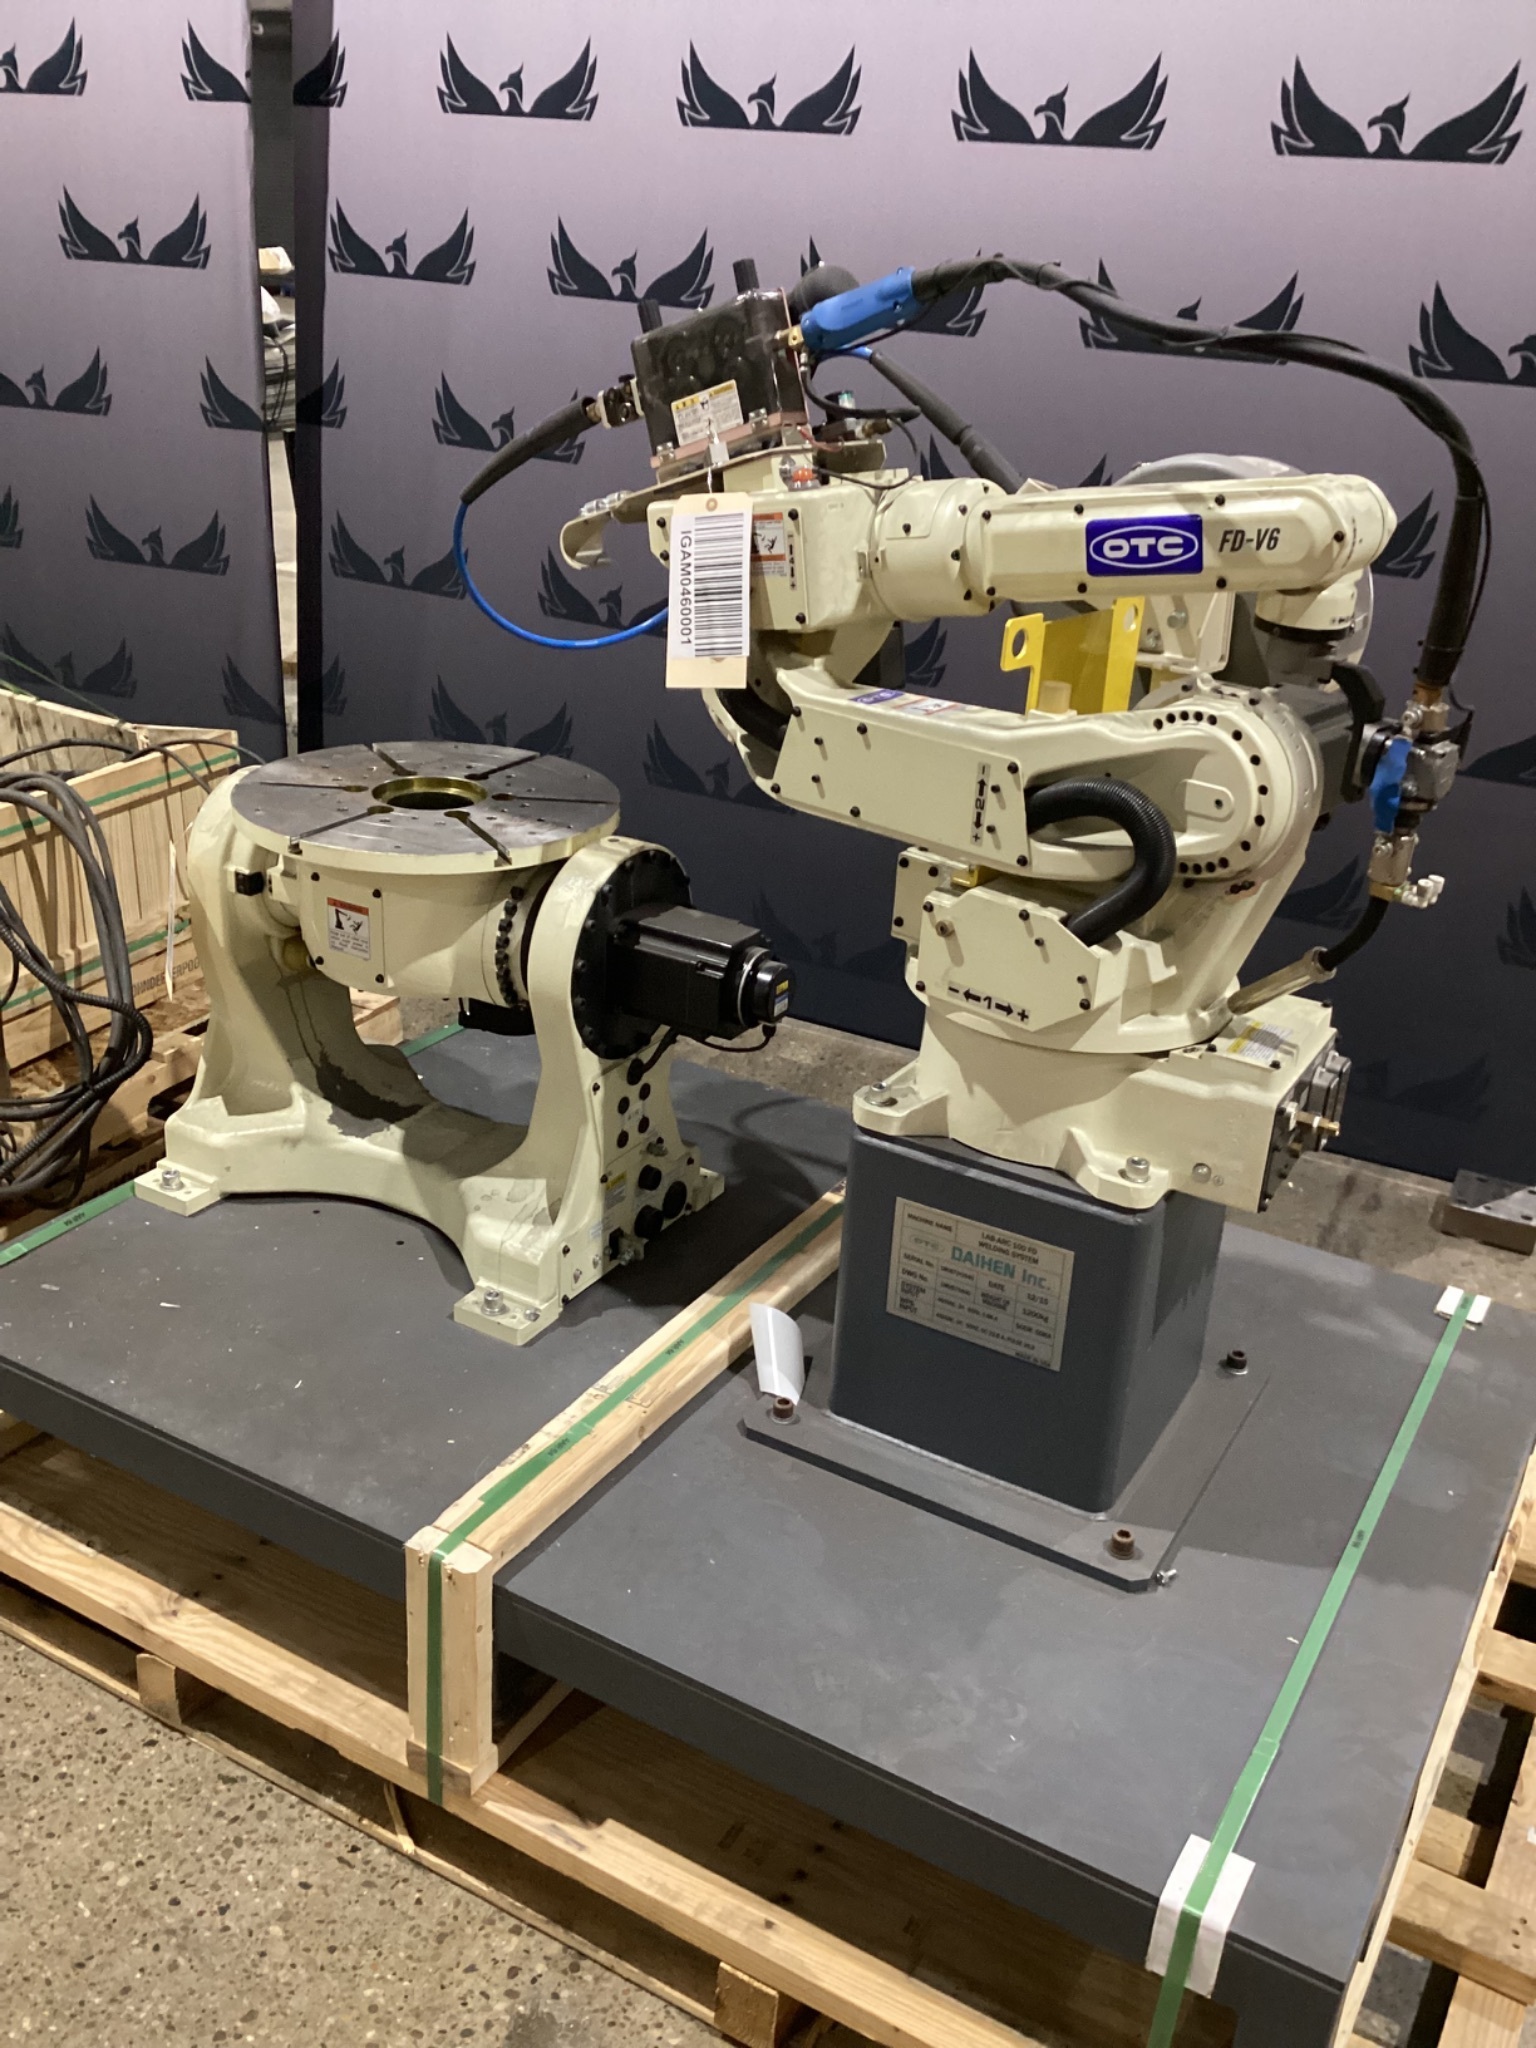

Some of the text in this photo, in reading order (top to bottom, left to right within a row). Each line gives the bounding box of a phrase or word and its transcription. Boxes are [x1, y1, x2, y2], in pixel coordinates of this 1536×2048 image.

[1102, 527, 1281, 559] OTC FD-V6
[680, 530, 692, 645] IGAM0460001
[983, 996, 992, 1010] 1
[935, 1222, 952, 1232] NAME
[978, 1241, 1039, 1265] WELDING SYSTEM
[951, 1246, 1016, 1279] DAIHEN
[1022, 1269, 1050, 1291] Inc.
